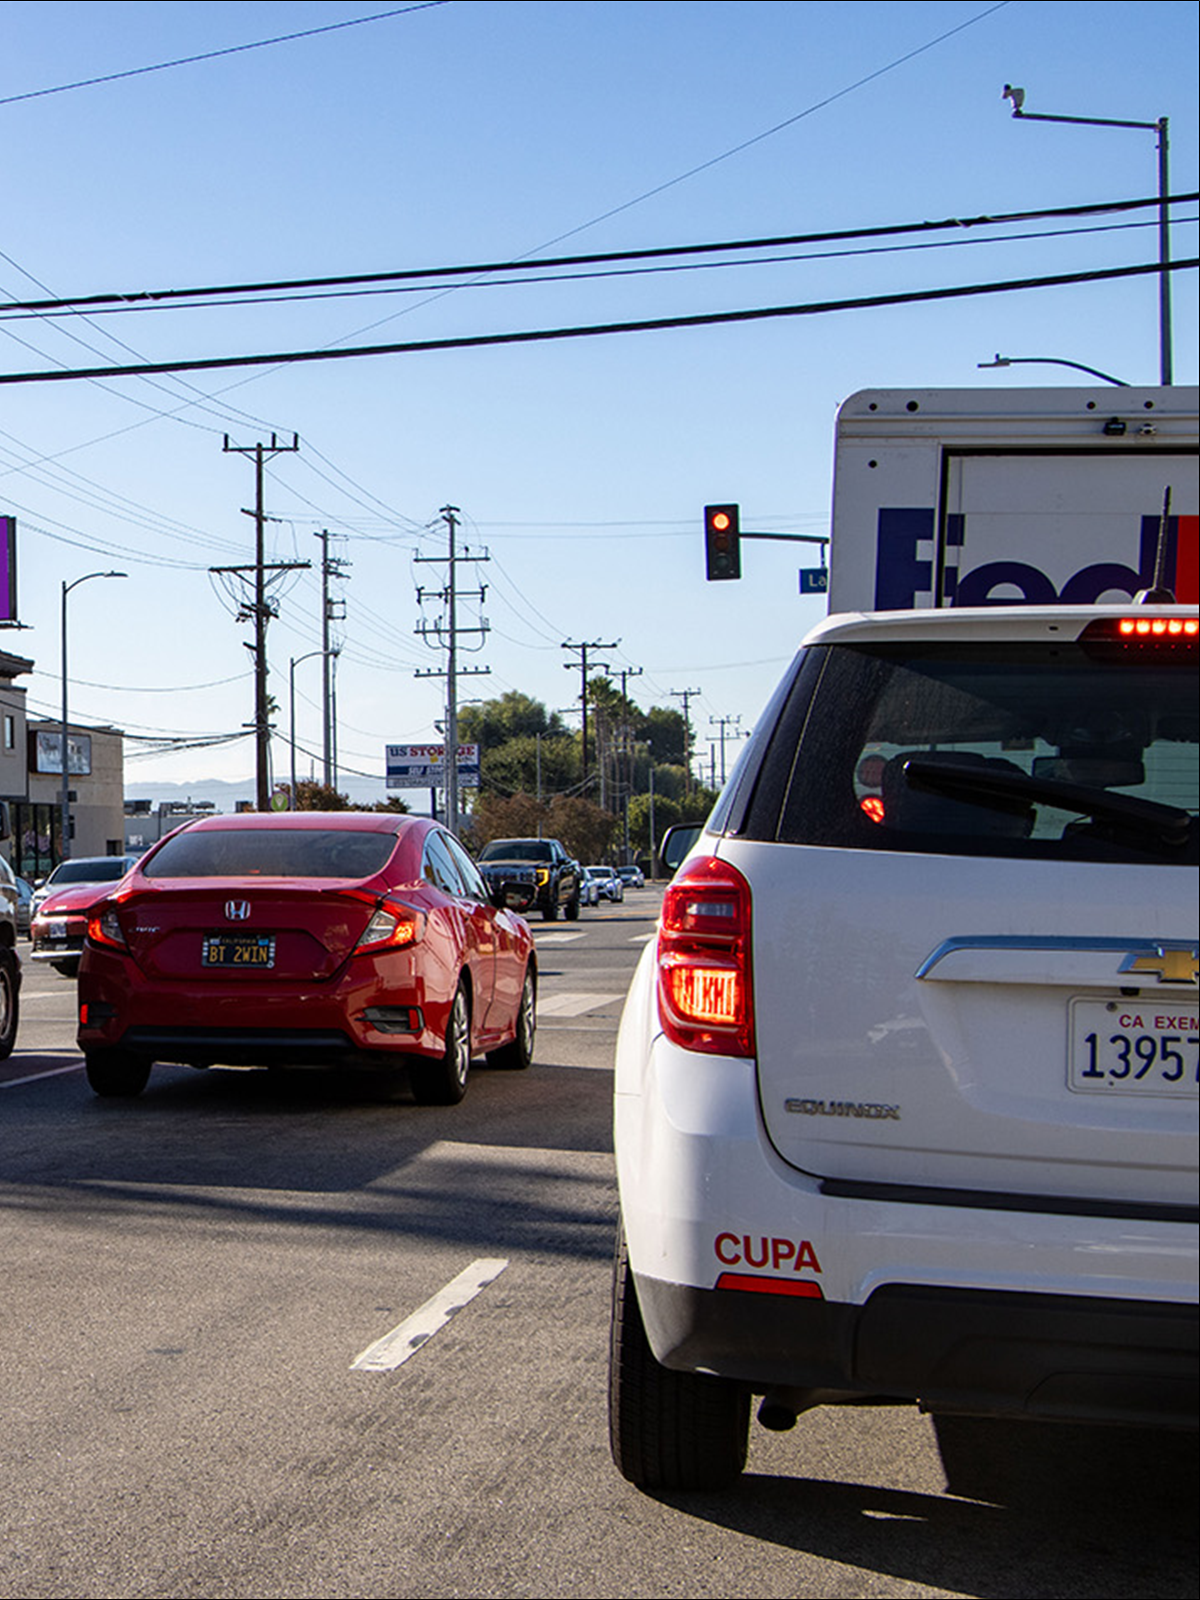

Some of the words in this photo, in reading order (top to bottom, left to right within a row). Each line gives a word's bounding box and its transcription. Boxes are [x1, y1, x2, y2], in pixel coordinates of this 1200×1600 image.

[874, 507, 1198, 607] Fed
[390, 747, 407, 757] US
[409, 746, 475, 757] STORGE
[209, 946, 226, 962] BT
[233, 946, 268, 962] 2WIN
[1119, 1014, 1144, 1028] CA
[785, 1098, 901, 1120] EQUINOX
[714, 1232, 822, 1274] CUPA
